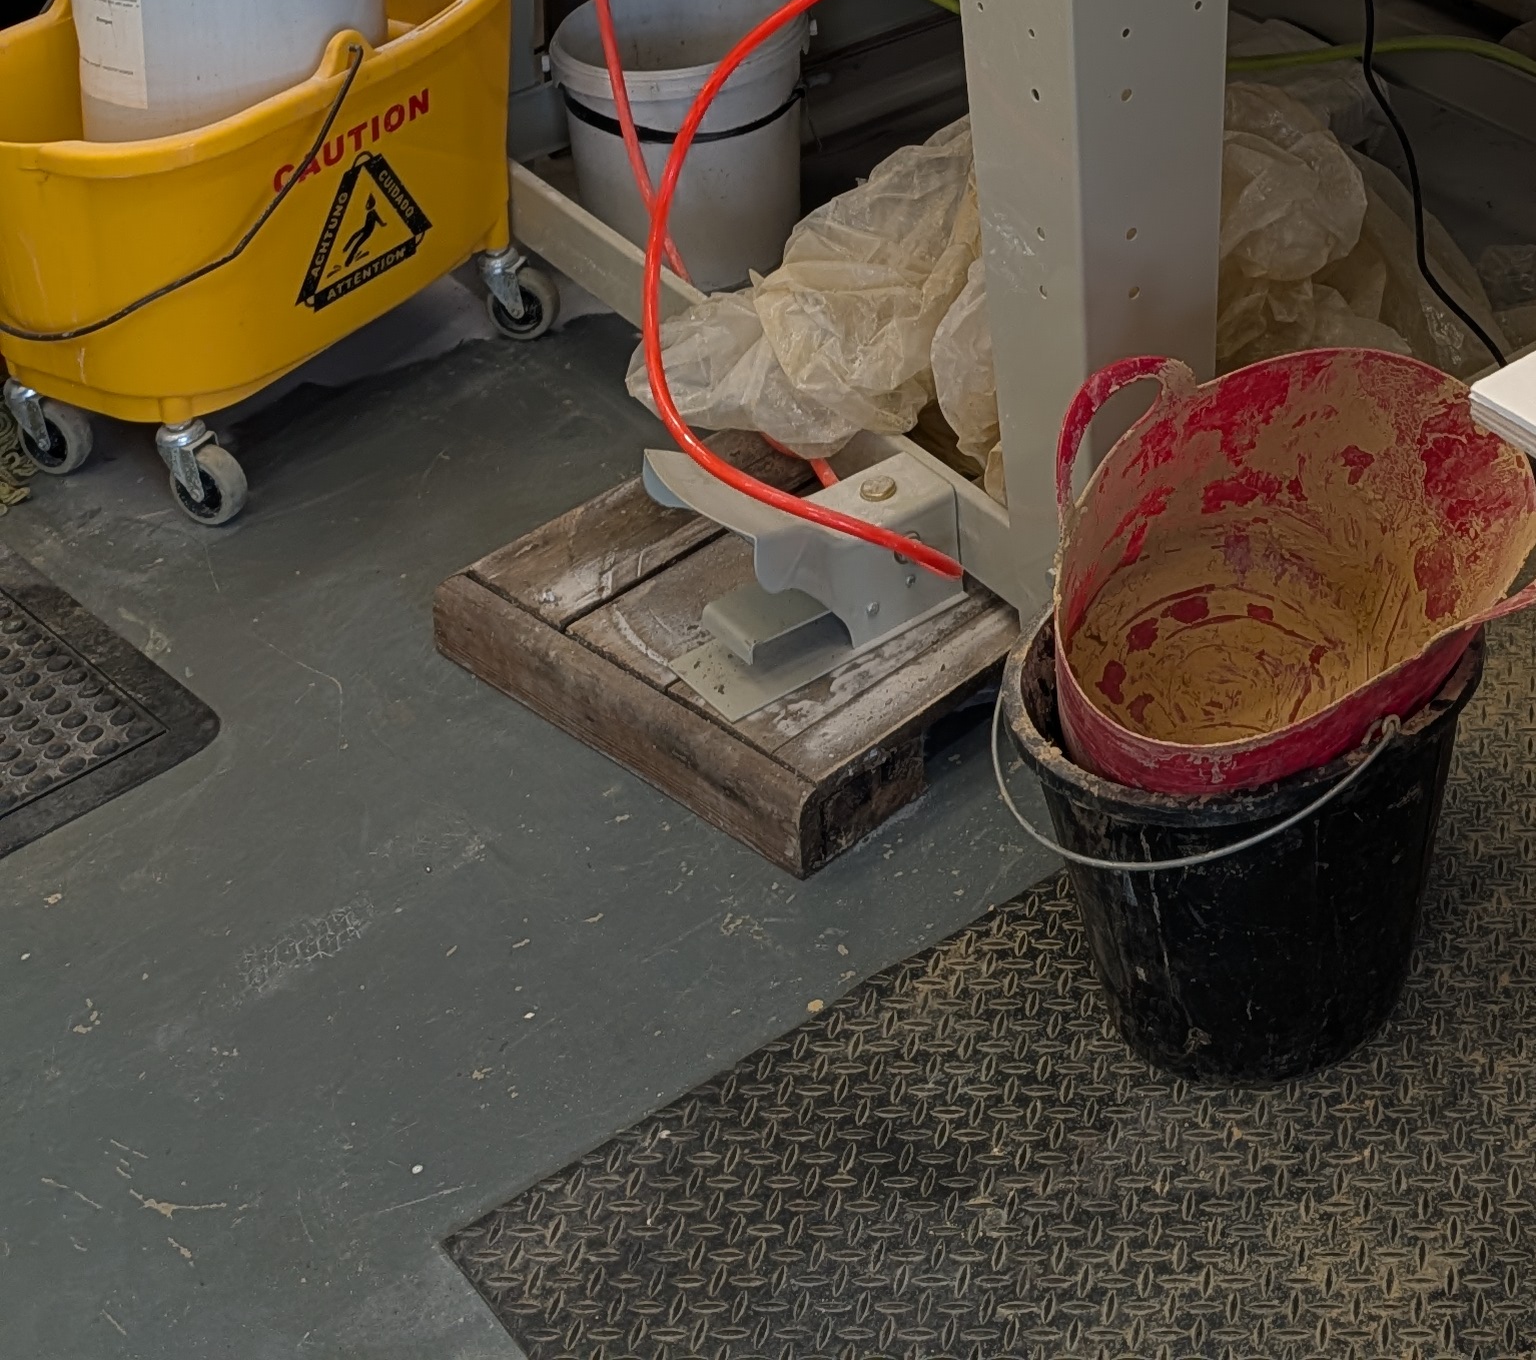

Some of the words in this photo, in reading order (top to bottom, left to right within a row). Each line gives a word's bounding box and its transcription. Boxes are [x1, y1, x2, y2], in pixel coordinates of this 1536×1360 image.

[273, 88, 430, 194] CAUTION
[377, 169, 416, 220] CUIDADO
[310, 191, 348, 279] ACHTUNG
[326, 246, 407, 301] ATTENTION
